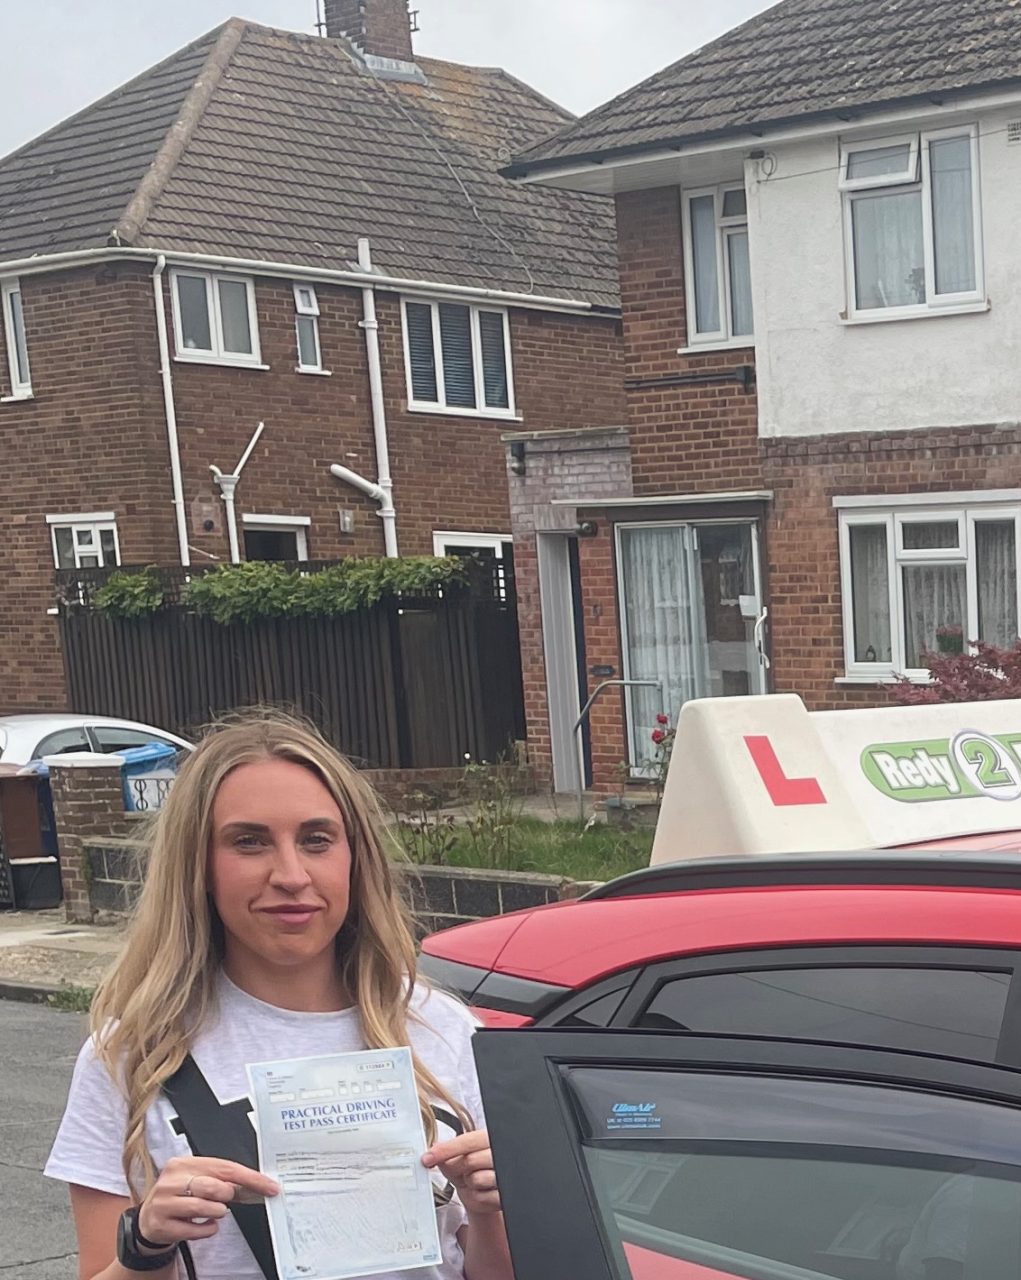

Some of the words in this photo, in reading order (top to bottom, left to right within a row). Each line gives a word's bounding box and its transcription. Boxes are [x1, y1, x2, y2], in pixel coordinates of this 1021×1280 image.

[743, 735, 828, 806] L
[870, 749, 961, 793] Redy
[961, 738, 1015, 788] 2
[281, 1104, 342, 1120] PRACTICAL
[346, 1098, 395, 1113] DRIVING
[284, 1119, 307, 1130] TEST
[310, 1116, 334, 1128] PASS
[337, 1109, 397, 1125] CERTIFICATE
